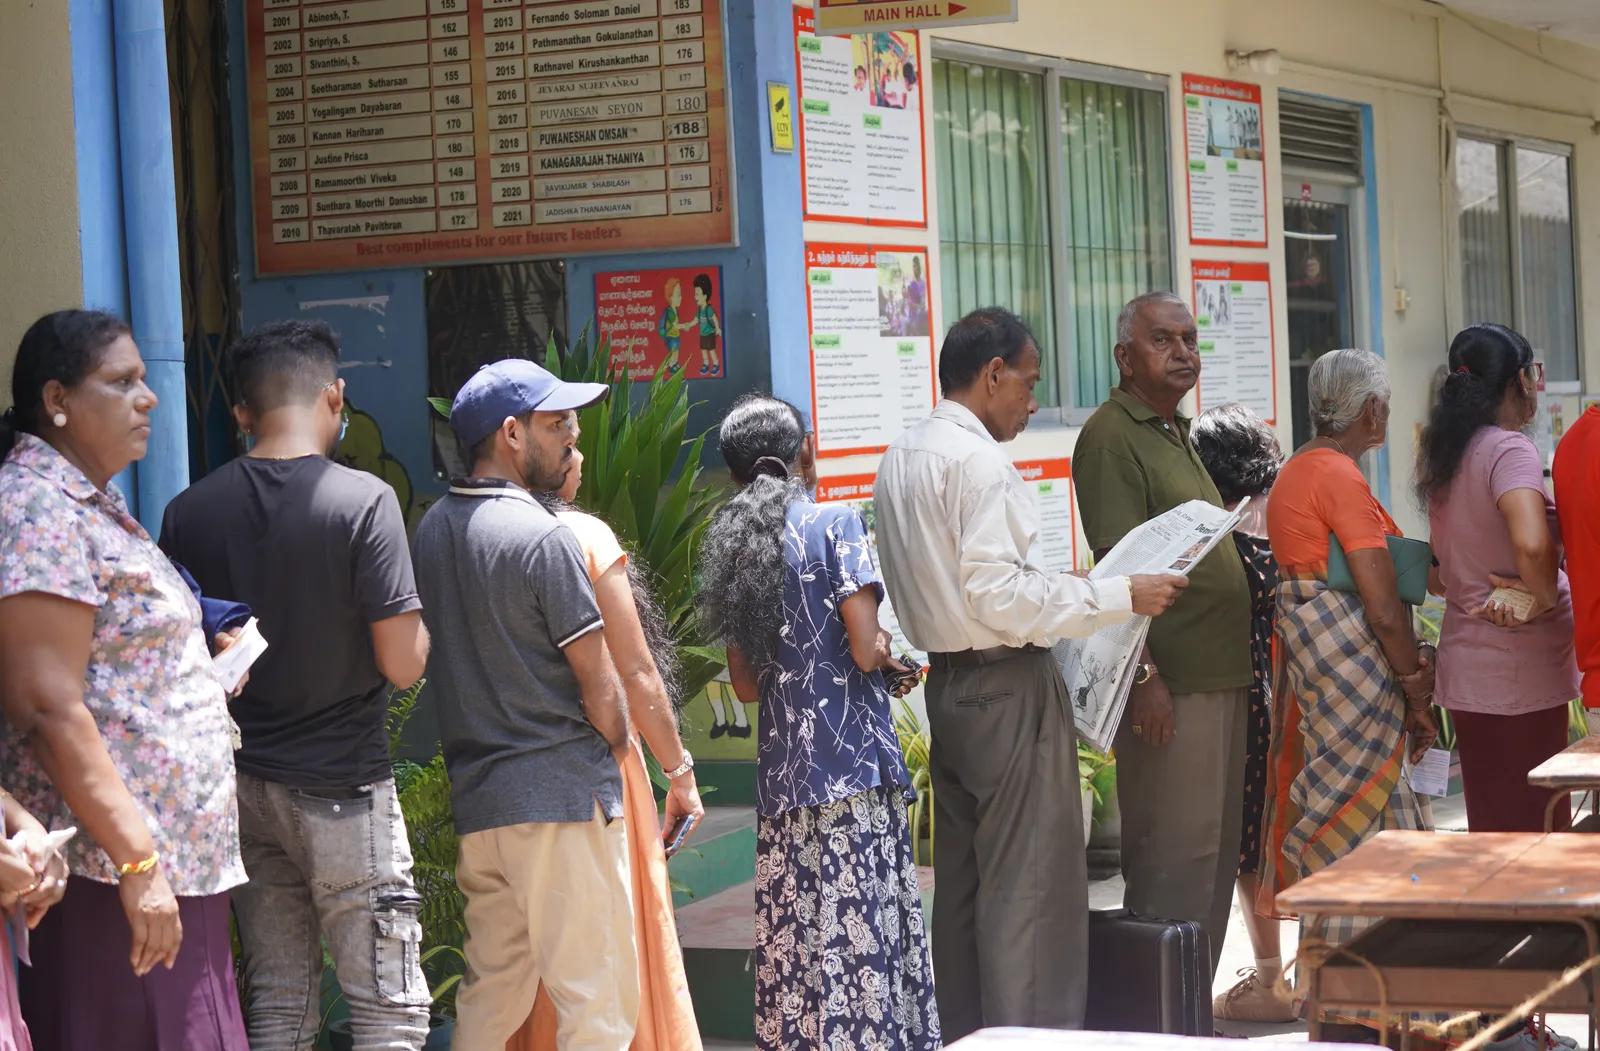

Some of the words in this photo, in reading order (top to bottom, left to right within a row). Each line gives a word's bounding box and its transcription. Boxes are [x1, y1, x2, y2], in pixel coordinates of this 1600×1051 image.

[272, 17, 290, 26] 2001
[308, 12, 341, 23] Abinesh,
[343, 10, 350, 20] T.
[493, 17, 513, 27] 2013
[532, 12, 570, 24] Fernando
[574, 8, 610, 20] Soloman
[615, 4, 640, 16] Daniel
[674, 0, 690, 10] 183
[864, 8, 900, 22] MAIN
[905, 4, 941, 18] HALL
[274, 40, 292, 50] 2002
[309, 36, 340, 48] Sripriya,
[342, 34, 350, 44] S.
[442, 22, 456, 32] 162
[494, 42, 514, 52] 2014
[533, 35, 591, 48] Pathmanathan
[596, 29, 653, 42] Gokulanathan
[675, 24, 691, 34] 183
[274, 64, 292, 74] 2003
[310, 58, 350, 69] Sivanthini,
[444, 47, 458, 56] 146
[496, 66, 516, 76] 2015
[534, 60, 574, 73] Rathnavel
[578, 54, 649, 68] Kirushankanthan
[677, 49, 692, 59] 176
[276, 87, 294, 97] 2004
[311, 82, 361, 94] Seetharaman
[368, 77, 408, 88] Sutharsan
[444, 71, 459, 81] 155
[497, 90, 517, 100] 2016
[538, 84, 575, 94] JEYARAJ
[579, 78, 639, 90] SUJEEVANRAJ
[679, 74, 692, 82] 177
[277, 111, 295, 121] 2005
[312, 106, 356, 118] Yogalingam
[361, 102, 402, 114] Dayabaran
[446, 95, 460, 104] 148
[498, 114, 518, 124] 2017
[540, 106, 599, 120] PUVANESAN
[608, 102, 643, 115] SEYON
[676, 97, 700, 110] 180
[278, 134, 296, 144] 2006
[313, 131, 341, 141] Kannan
[346, 128, 384, 138] Hariharan
[447, 119, 461, 129] 170
[500, 138, 519, 148] 2018
[540, 130, 596, 145] PUWANESHAN
[599, 127, 628, 140] OMSAN
[674, 122, 700, 134] 188
[278, 158, 296, 167] 2007
[314, 154, 342, 164] Justine
[344, 152, 368, 162] Prisca
[448, 143, 462, 153] 180
[500, 163, 520, 173] 2019
[540, 155, 604, 169] KANAGARAJAH
[606, 152, 644, 165] THANIYA
[679, 147, 695, 158] 176
[280, 182, 298, 191] 2008
[315, 176, 366, 188] Ramamoorthi
[371, 173, 396, 183] Viveka
[449, 167, 463, 177] 149
[502, 188, 521, 197] 2020
[592, 180, 630, 188] SHABILASH
[281, 205, 299, 214] 2009
[316, 201, 350, 212] Sunthara
[356, 198, 384, 209] Moorthi
[390, 195, 428, 206] Danushan
[450, 191, 464, 201] 178
[503, 211, 522, 221] 2021
[580, 204, 631, 214] THANANJAYAN
[282, 228, 300, 238] 2010
[365, 221, 402, 232] Pavithran
[452, 216, 466, 225] 172
[357, 242, 384, 256] Best
[386, 236, 472, 254] compliments
[474, 234, 496, 247] for
[498, 234, 522, 246] our
[526, 230, 568, 244] future
[571, 226, 622, 240] leaders
